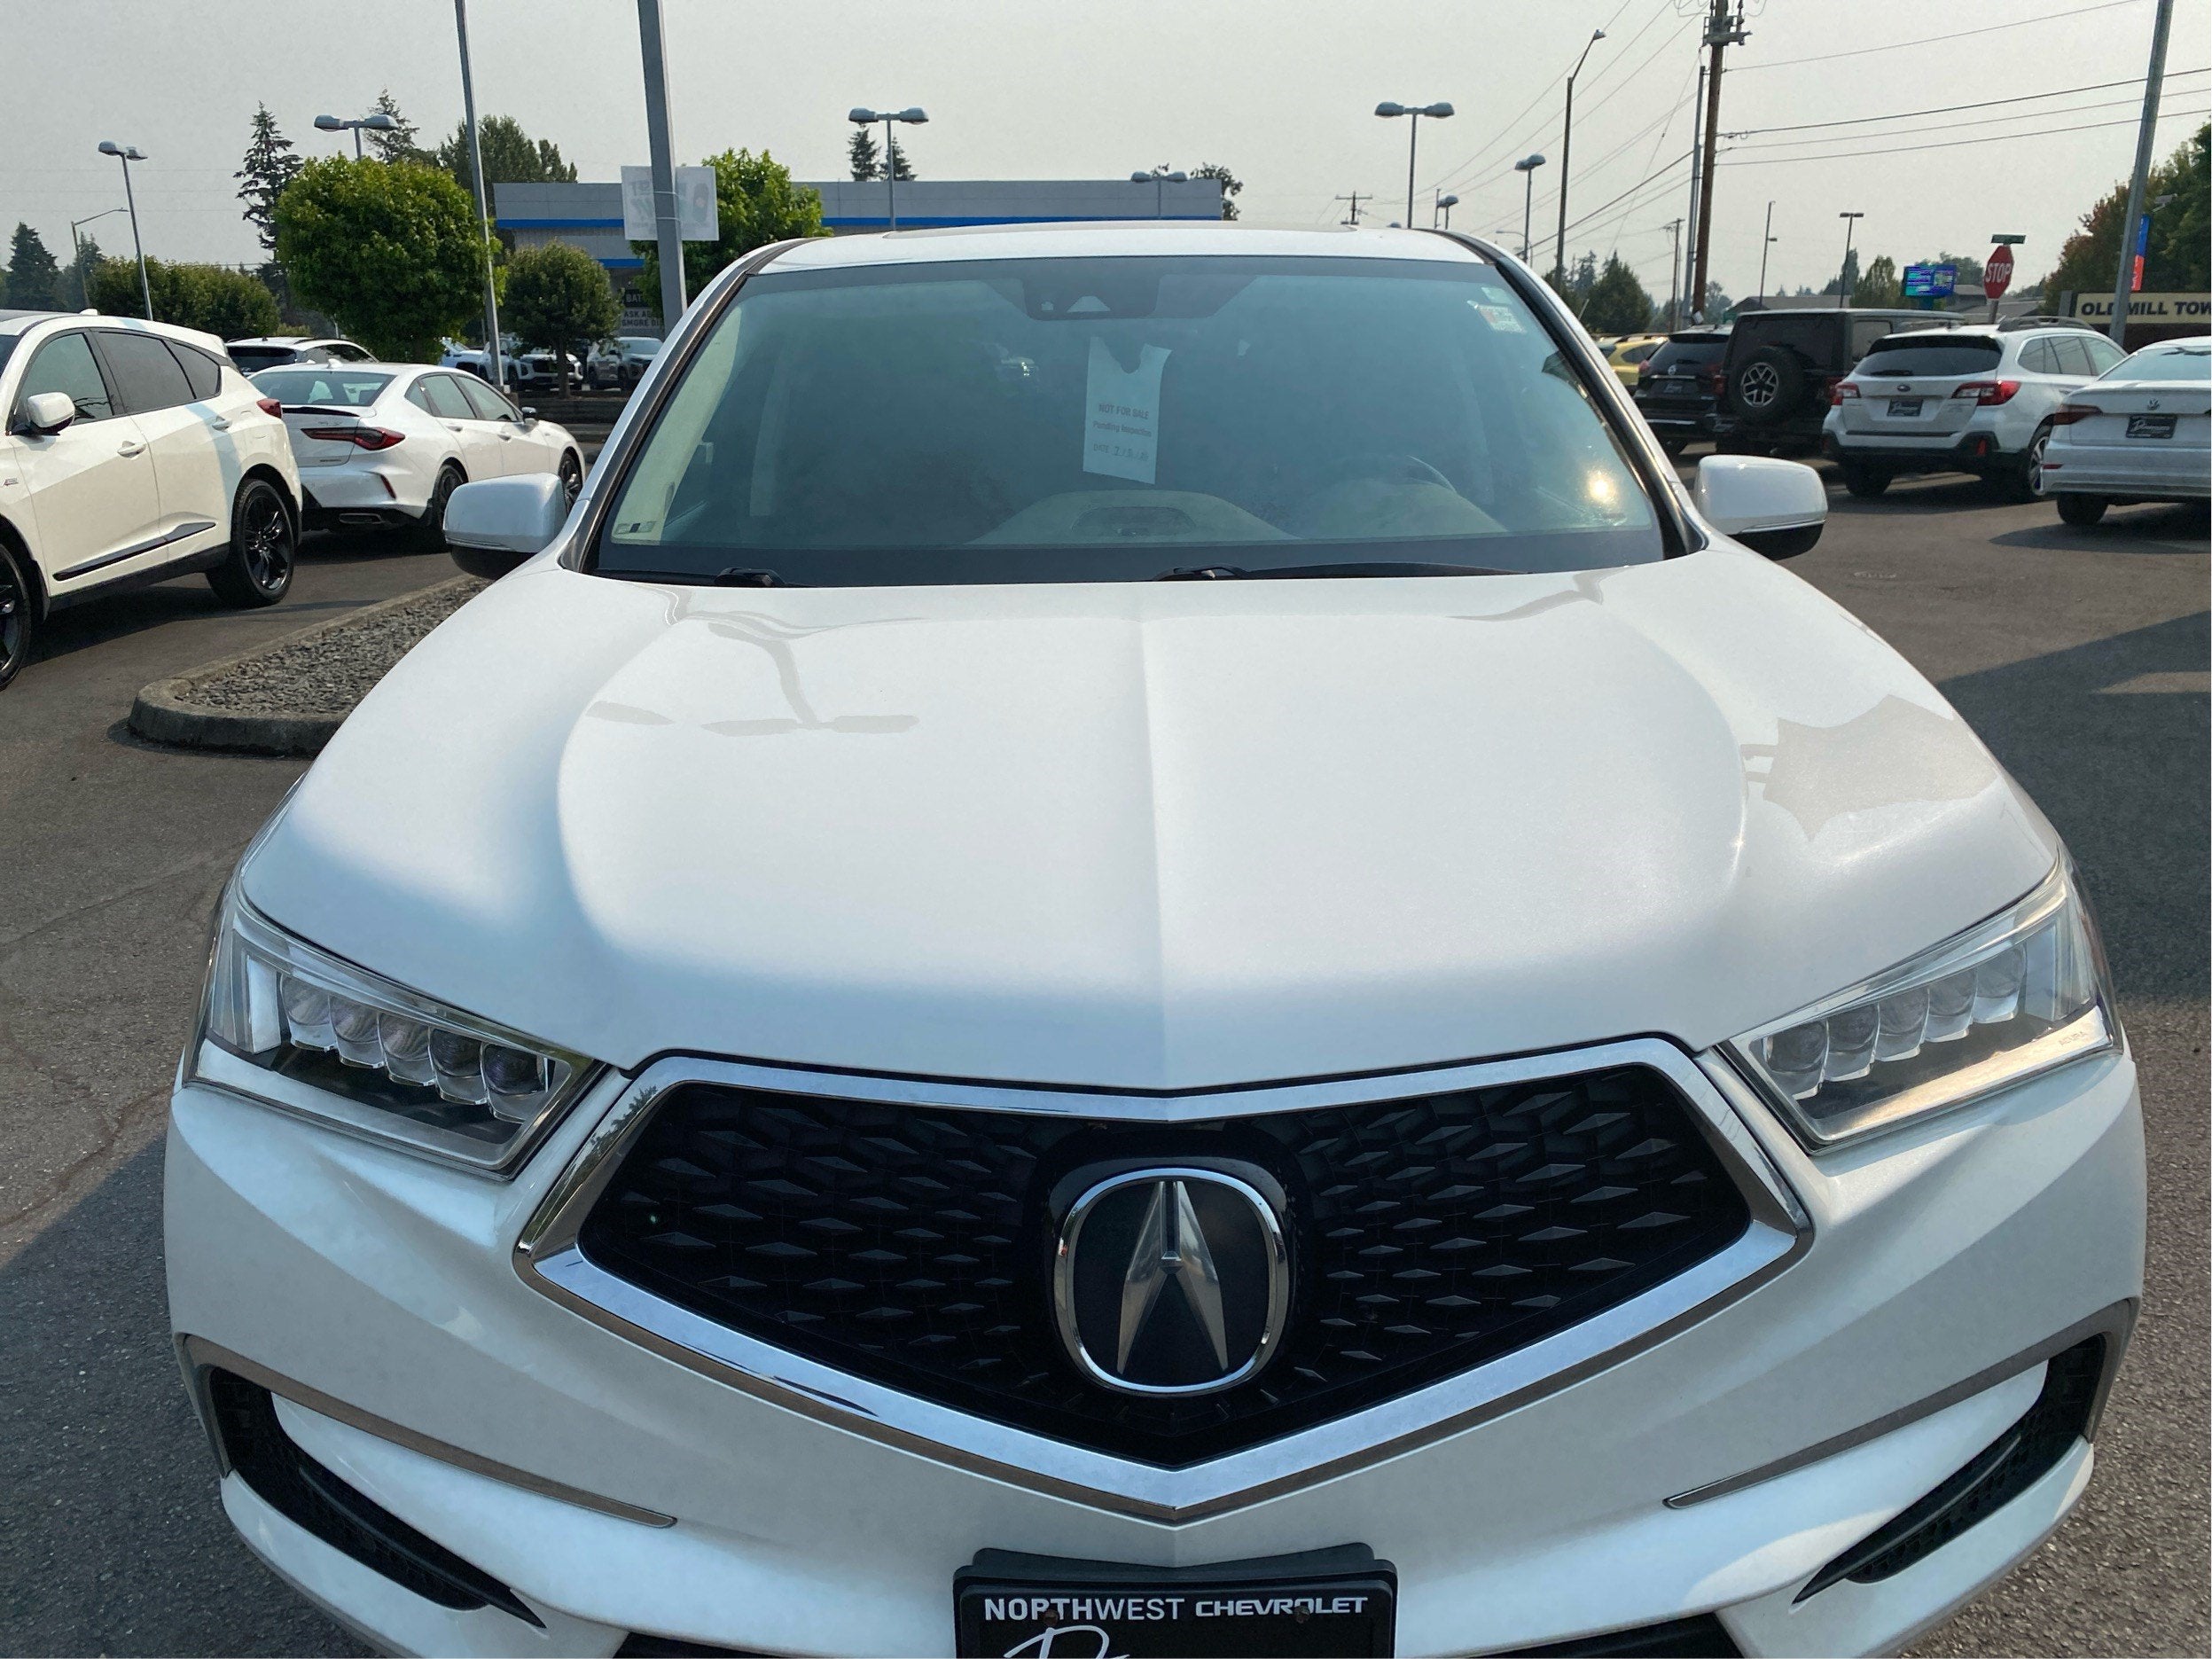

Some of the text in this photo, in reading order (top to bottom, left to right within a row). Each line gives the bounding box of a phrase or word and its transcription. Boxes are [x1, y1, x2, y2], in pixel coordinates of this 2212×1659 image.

[1985, 262, 2012, 283] STOP
[2127, 301, 2168, 316] MILL
[1098, 403, 1150, 419] NOT FOR SALE
[985, 1596, 1368, 1621] NORTHWEST CHEVROLET
